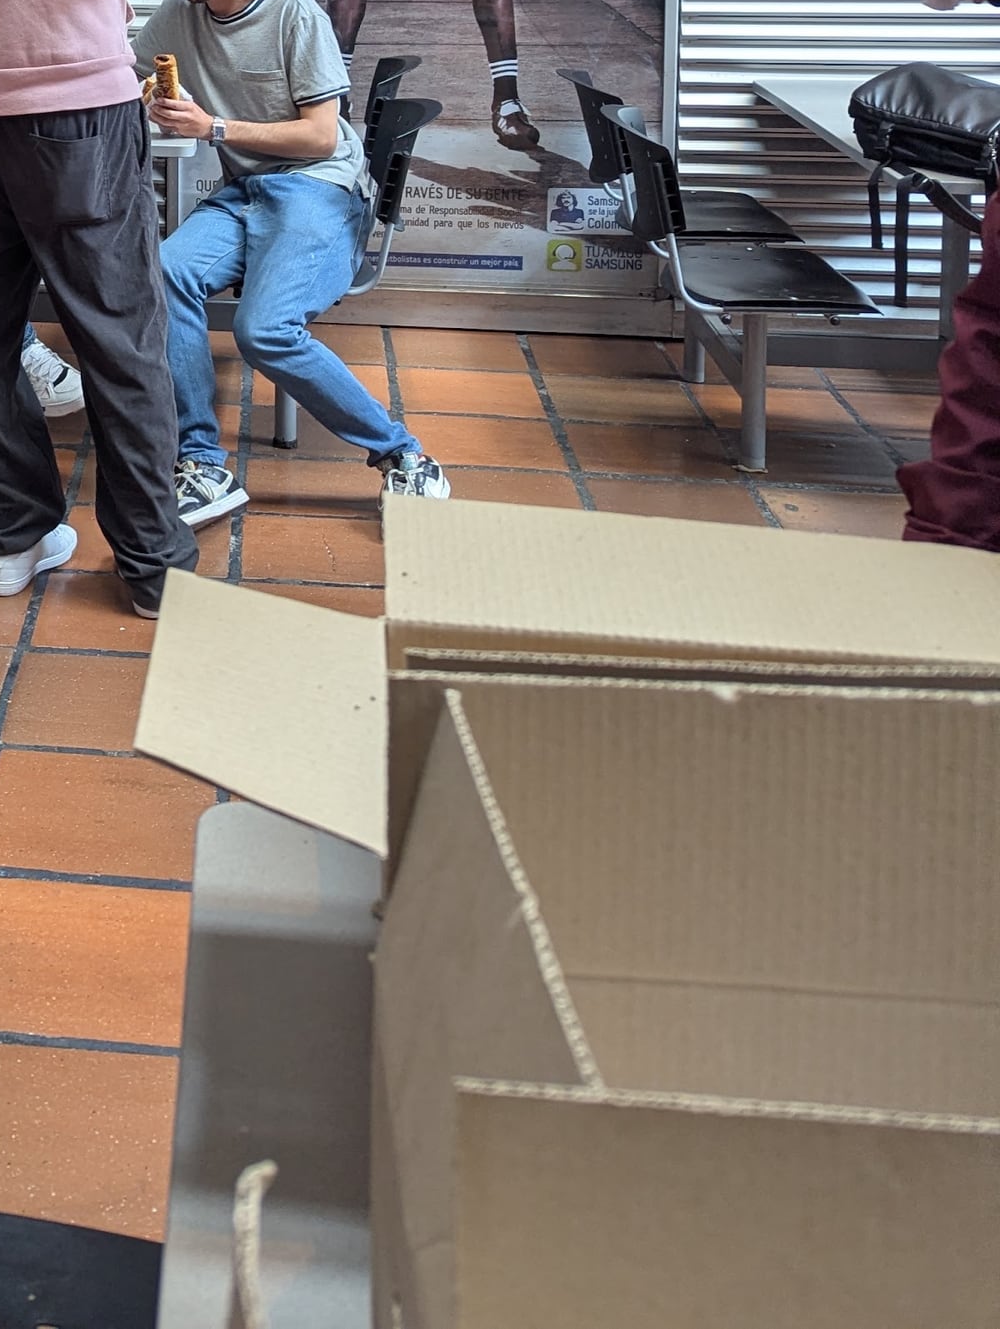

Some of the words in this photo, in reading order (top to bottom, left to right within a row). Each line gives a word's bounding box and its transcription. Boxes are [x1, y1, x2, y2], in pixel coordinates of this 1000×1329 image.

[405, 184, 443, 199] RAVÉS
[446, 187, 462, 199] DE
[465, 187, 481, 200] SU
[485, 188, 526, 201] GENTE
[587, 195, 619, 207] Samsu
[415, 205, 425, 214] de
[433, 220, 452, 229] para
[457, 221, 472, 231] que
[477, 219, 489, 229] los
[494, 221, 524, 230] nuevos
[584, 245, 601, 258] TU
[433, 256, 468, 265] construir
[481, 258, 501, 267] mejor
[584, 258, 643, 270] SAMSUNG
